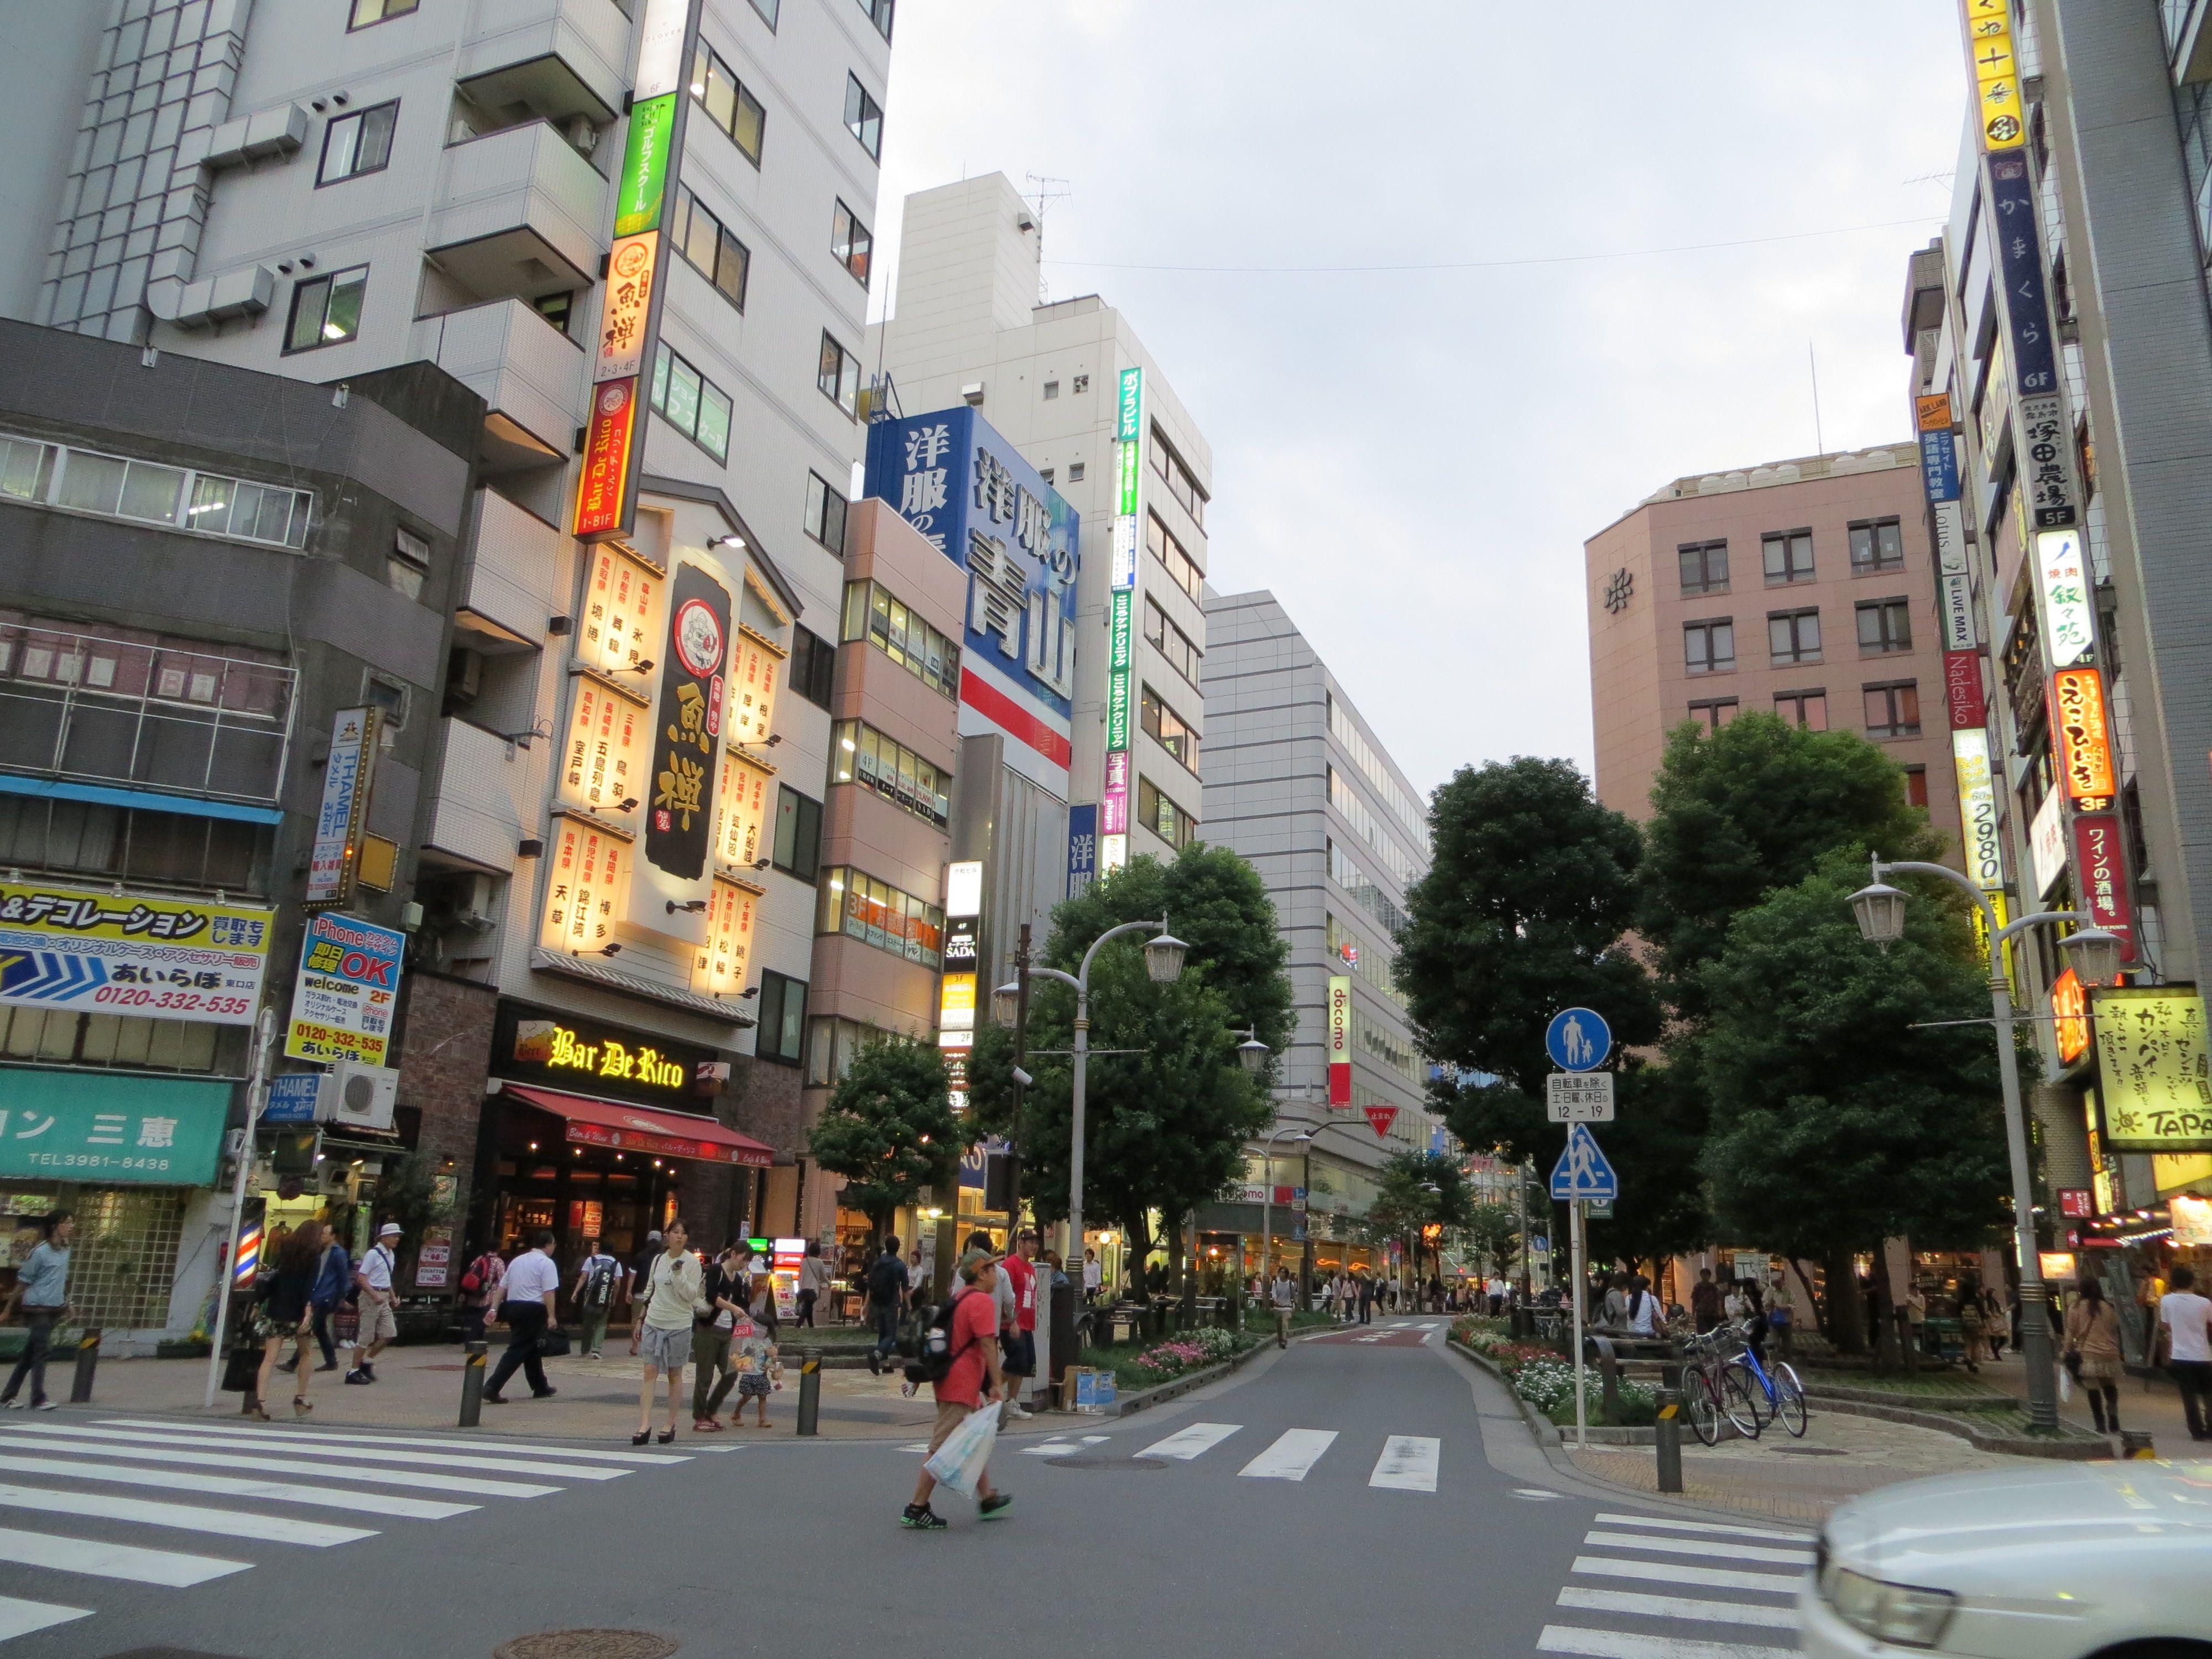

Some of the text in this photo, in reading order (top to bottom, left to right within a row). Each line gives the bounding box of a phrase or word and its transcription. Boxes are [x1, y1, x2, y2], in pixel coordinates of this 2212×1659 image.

[645, 28, 682, 43] CLOVER
[650, 82, 661, 93] 6F
[634, 127, 654, 212] ゴルフスクール
[1998, 199, 2039, 344] かまくら
[2025, 372, 2048, 387] 6F
[1924, 433, 1944, 499] 英語専門教室
[973, 447, 1076, 585] 洋服の
[1936, 506, 1950, 547] Lotus
[2046, 512, 2067, 524] 5F
[617, 570, 630, 605] 京都府
[2048, 568, 2078, 580] 焼肉
[638, 583, 651, 617] 富山県
[965, 527, 1076, 701] 青山
[2049, 584, 2086, 647] 叙々苑
[587, 602, 603, 641] 境港
[608, 615, 623, 654] 舞鶴
[1114, 594, 1129, 666] こころケアクリニック
[2076, 654, 2095, 663] 4F
[1949, 656, 1973, 724] Nadesiko
[580, 691, 593, 728] 高知県
[757, 703, 768, 737] 根室
[1112, 674, 1126, 748] こころケアクリニック
[622, 713, 634, 748] 三重県
[330, 753, 342, 788] タメル
[568, 739, 586, 787] 室戸岬
[589, 741, 608, 803] 五島列島
[612, 759, 627, 799] 鳥羽
[863, 755, 873, 769] 4F
[1108, 752, 1125, 785] 写真
[332, 750, 358, 837] THAMEL
[2080, 797, 2107, 811] 3F
[1104, 799, 1114, 830] phopro
[561, 832, 575, 870] 熊本県
[728, 815, 740, 855] 気仙沼
[744, 823, 757, 863] 大船渡
[582, 835, 598, 884] 鹿児島県
[604, 849, 618, 886] 福岡県
[2089, 828, 2116, 917] ワインの酒場。
[551, 885, 567, 925] 天草
[572, 889, 590, 938] 錦江湾
[596, 899, 611, 938] 博多
[723, 889, 734, 933] 神奈川県
[740, 901, 750, 933] 千葉県
[849, 895, 867, 915] 3F
[212, 916, 265, 933] 買取も
[212, 930, 264, 947] します
[314, 917, 364, 947] iPhone
[366, 931, 399, 948] カスタム
[307, 954, 338, 973] 修理
[315, 941, 345, 958] 即日
[364, 941, 398, 956] デザイン
[733, 945, 745, 979] 銚子
[946, 946, 975, 958] SADA
[112, 963, 256, 990] あいらぼ 東口店
[305, 977, 359, 994] welcome
[341, 951, 396, 986] OK
[95, 986, 250, 1015] 0120-332-535
[305, 1000, 347, 1015] オリジナルケース
[362, 1003, 388, 1019] iPhone
[369, 990, 392, 1004] 2F
[304, 1009, 347, 1025] アクセサリー販売
[362, 1016, 385, 1026] 買取も
[362, 1024, 384, 1034] します
[1334, 989, 1346, 1050] docomo
[296, 1024, 383, 1052] 0120-332-535
[301, 1041, 360, 1061] あいらぼ
[961, 1034, 971, 1042] 2F
[548, 1026, 684, 1088] Bar De Rico
[273, 1078, 317, 1097] THAMEL
[1552, 1077, 1607, 1089] 自転車を除く
[1552, 1091, 1608, 1104] 土・日曜、休日の
[87, 1113, 178, 1148] 三恵
[598, 1285, 608, 1305] YONEX
